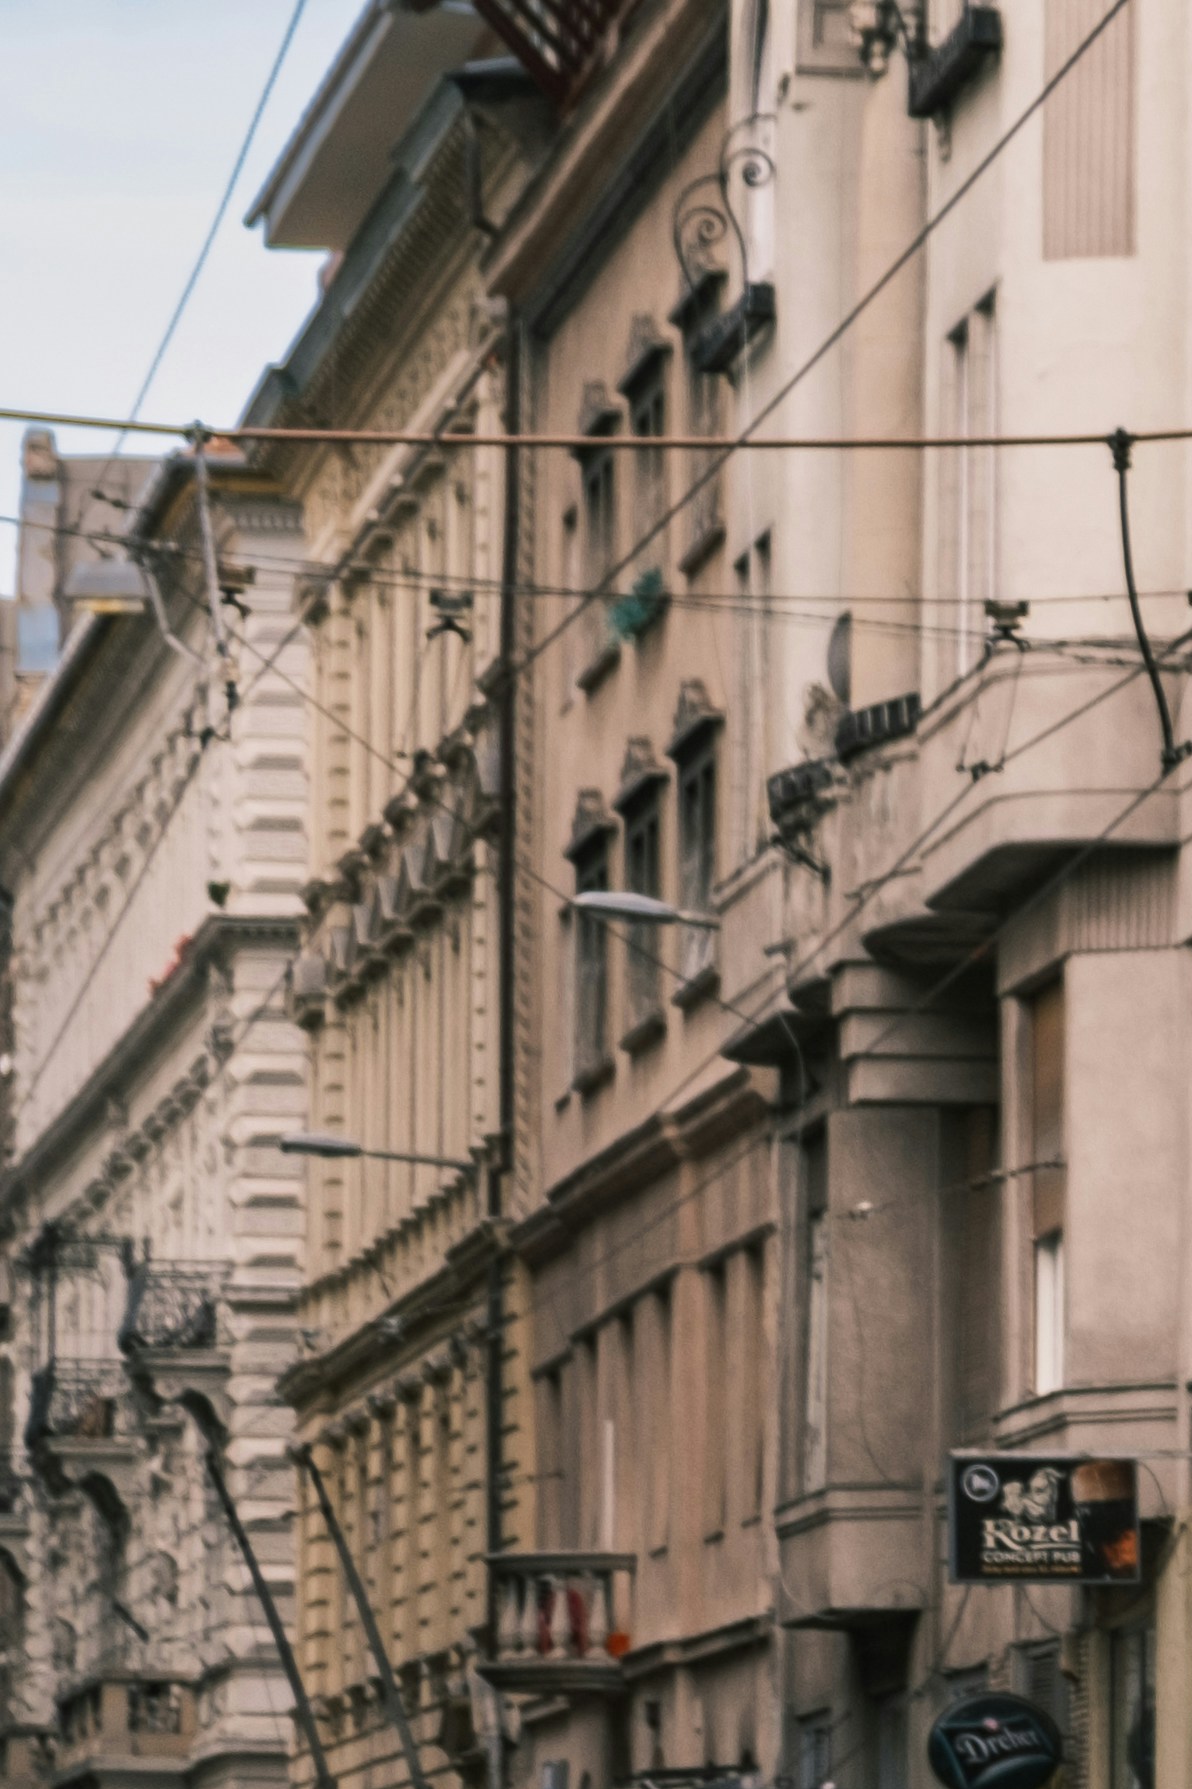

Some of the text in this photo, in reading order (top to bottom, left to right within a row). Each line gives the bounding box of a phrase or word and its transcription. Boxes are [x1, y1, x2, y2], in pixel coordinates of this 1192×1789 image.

[982, 1518, 1081, 1551] Kozel
[983, 1552, 1081, 1563] CONCEPT PUB
[955, 1725, 1040, 1762] Dreher
